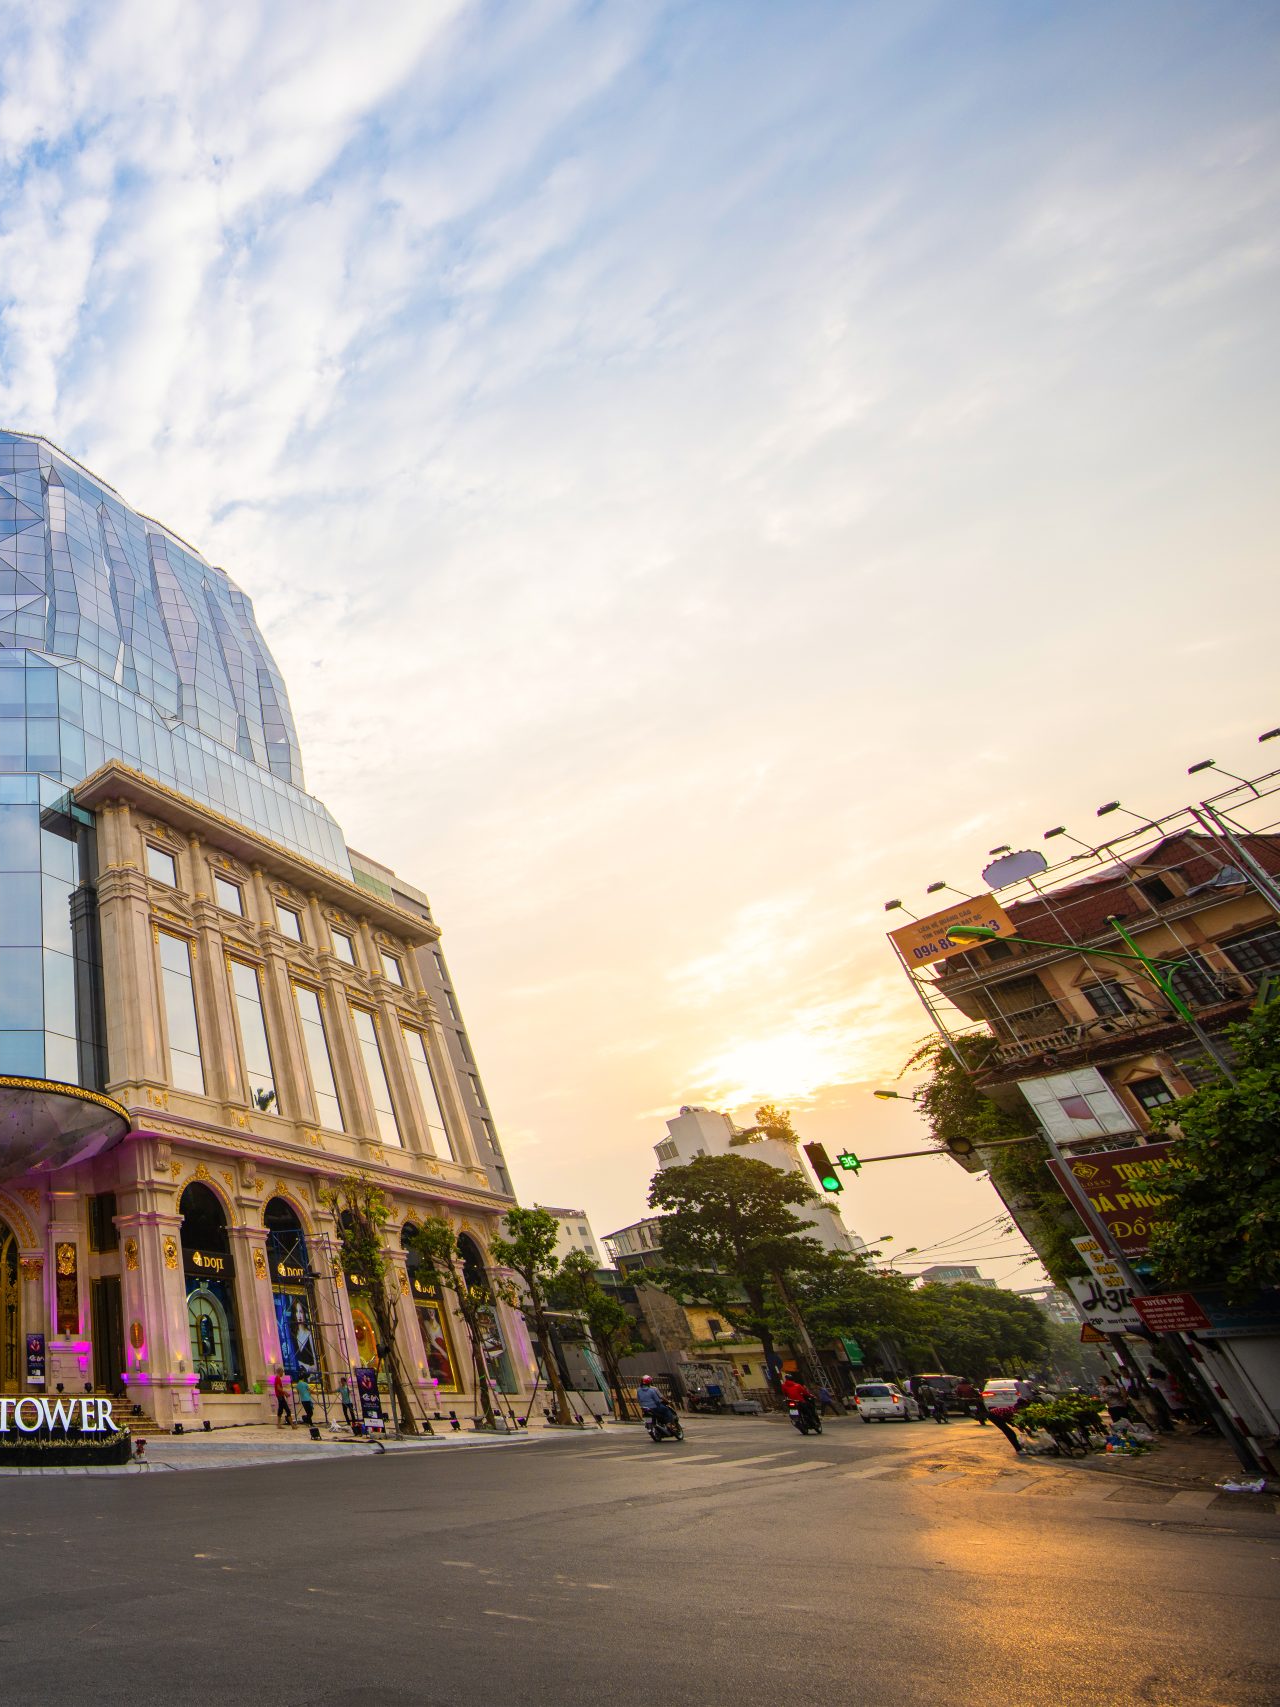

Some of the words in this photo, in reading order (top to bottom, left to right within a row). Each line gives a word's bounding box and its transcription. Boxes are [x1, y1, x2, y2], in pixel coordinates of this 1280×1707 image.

[913, 943, 938, 959] 094
[841, 1156, 857, 1167] 36
[204, 1256, 225, 1273] DOJI
